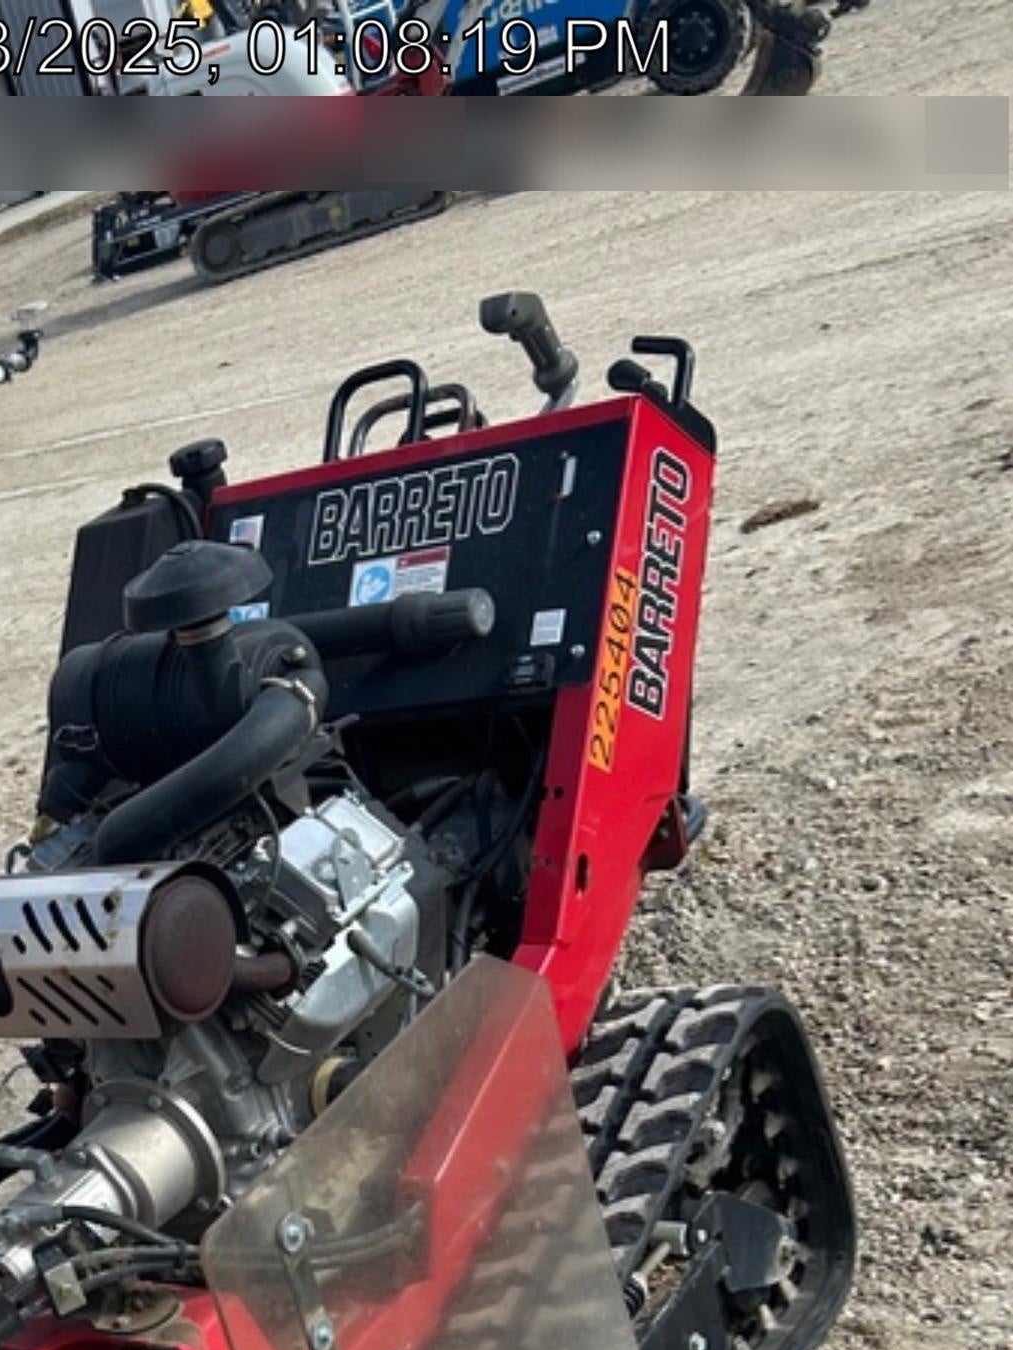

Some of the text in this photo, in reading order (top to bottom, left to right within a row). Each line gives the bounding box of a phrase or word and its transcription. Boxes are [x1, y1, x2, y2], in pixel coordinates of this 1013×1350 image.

[309, 453, 519, 565] BARRETO
[626, 447, 690, 720] BARRETO
[590, 570, 637, 767] 225404
